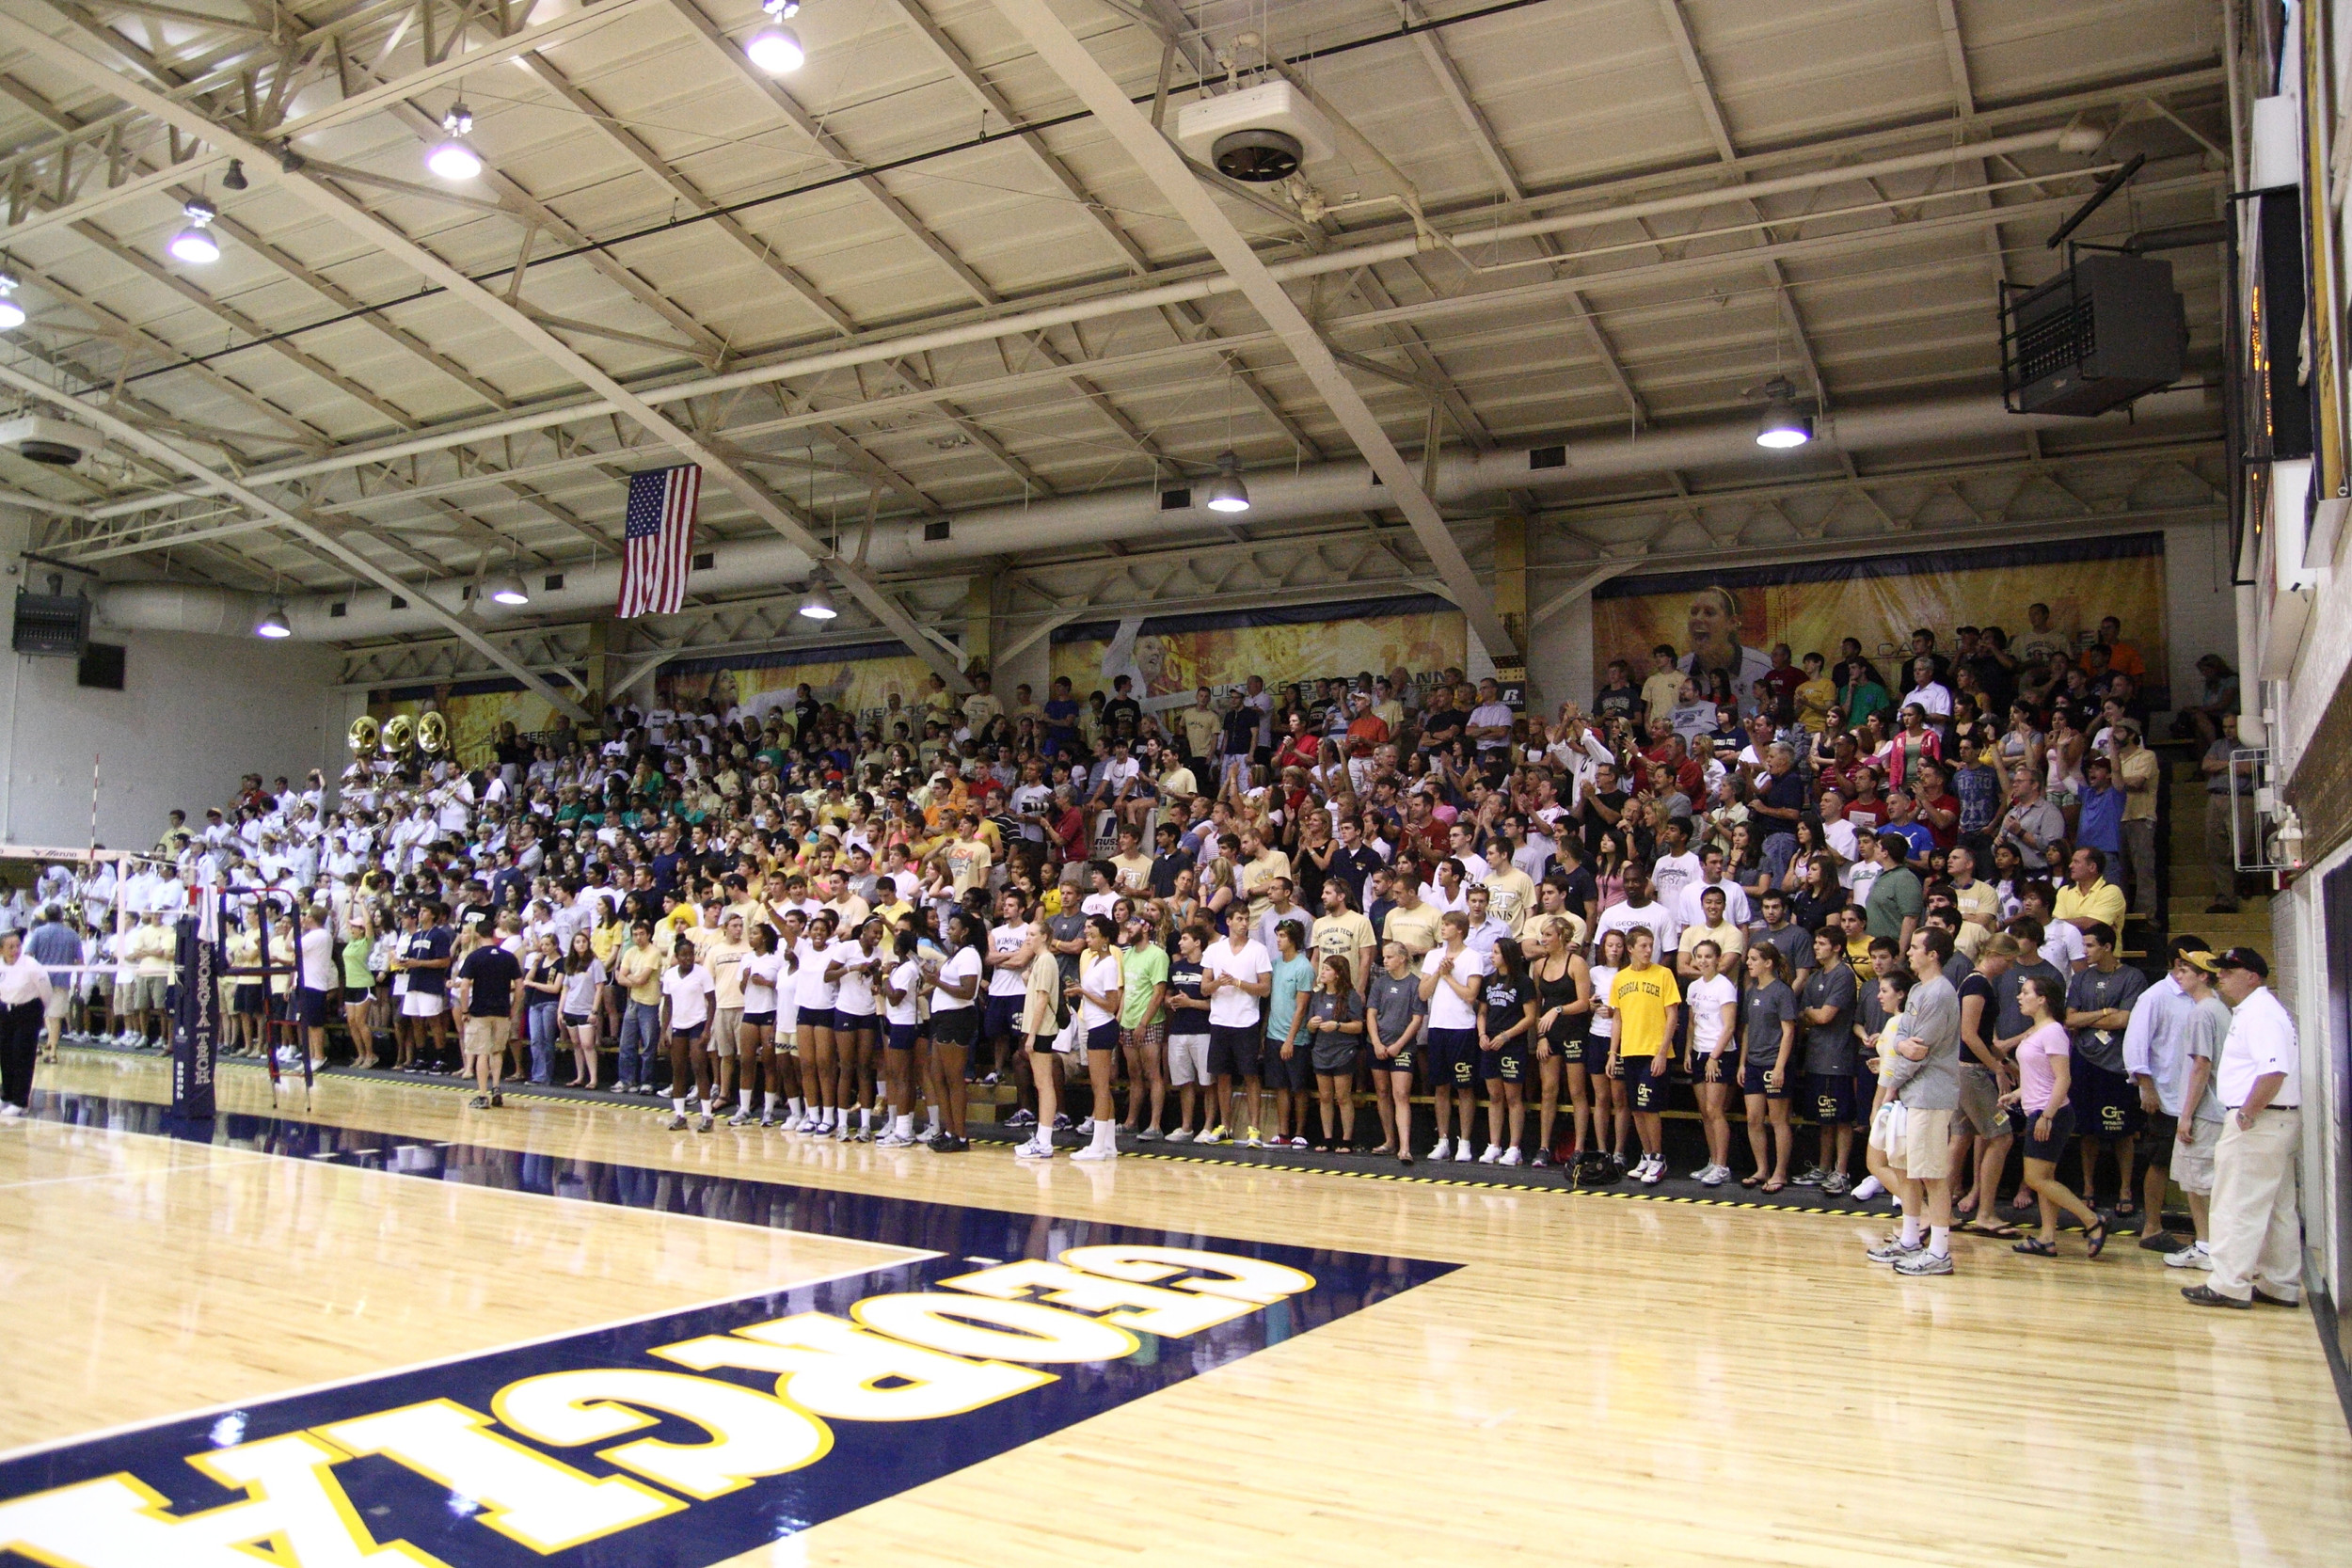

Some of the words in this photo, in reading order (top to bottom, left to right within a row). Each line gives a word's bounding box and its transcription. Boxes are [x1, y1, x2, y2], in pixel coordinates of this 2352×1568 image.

[1340, 927, 1354, 940] TECH
[196, 942, 211, 1028] GEORGIA
[1618, 982, 1639, 1000] GEORGIA
[1642, 982, 1661, 998] TECH
[195, 1033, 211, 1085] TECH
[1502, 1056, 1519, 1069] GT
[1454, 1062, 1472, 1073] GT
[1638, 1083, 1652, 1098] GT
[2102, 1105, 2125, 1120] GT
[0, 1243, 1316, 1568] GEORGIA
